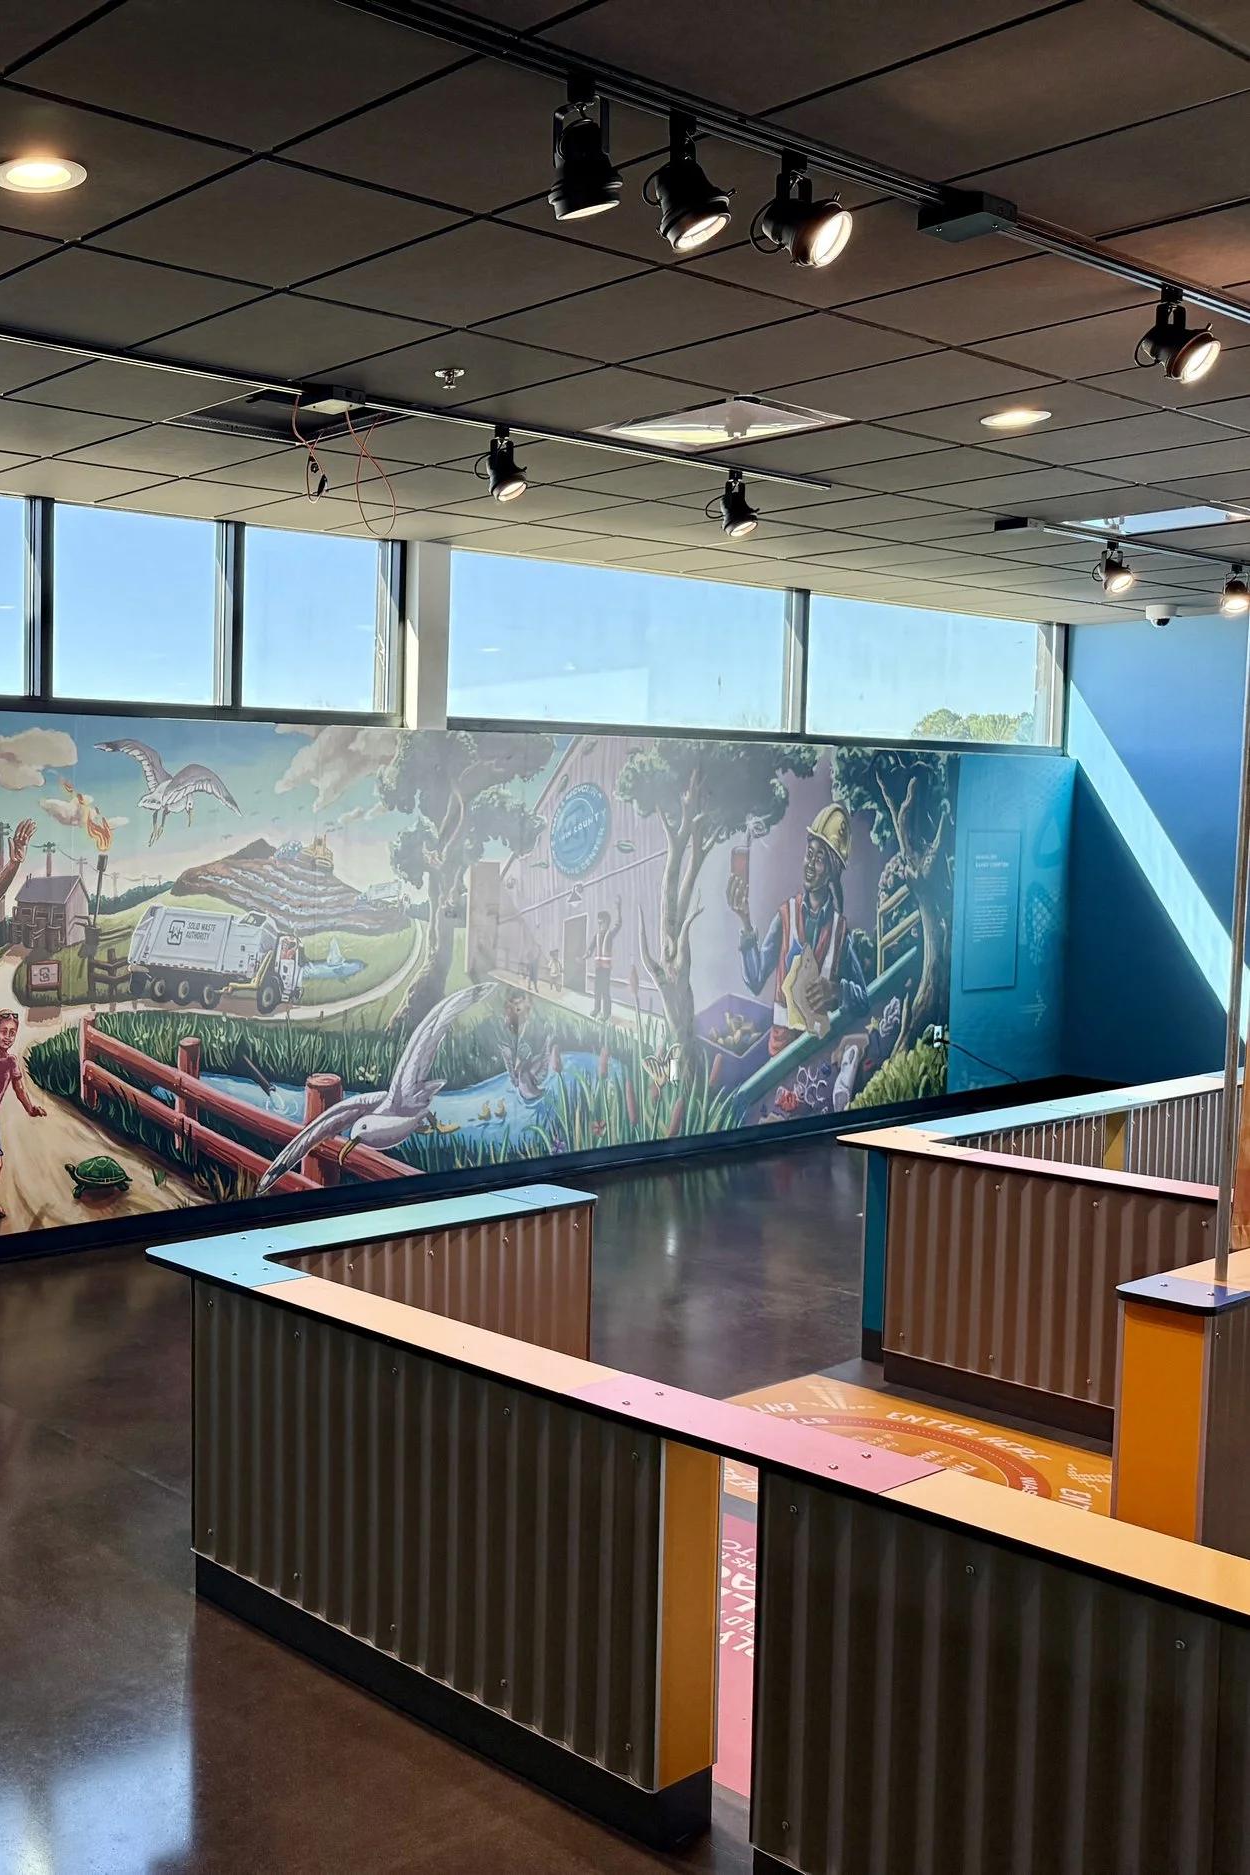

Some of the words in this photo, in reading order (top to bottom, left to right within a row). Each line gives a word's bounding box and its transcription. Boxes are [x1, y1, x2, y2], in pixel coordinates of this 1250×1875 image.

[574, 808, 606, 833] COUNTY
[185, 931, 210, 940] AUTHORITY
[187, 921, 200, 930] SOLID
[201, 923, 216, 932] WASTE
[886, 1411, 979, 1436] ENTER
[978, 1436, 1052, 1461] HERE
